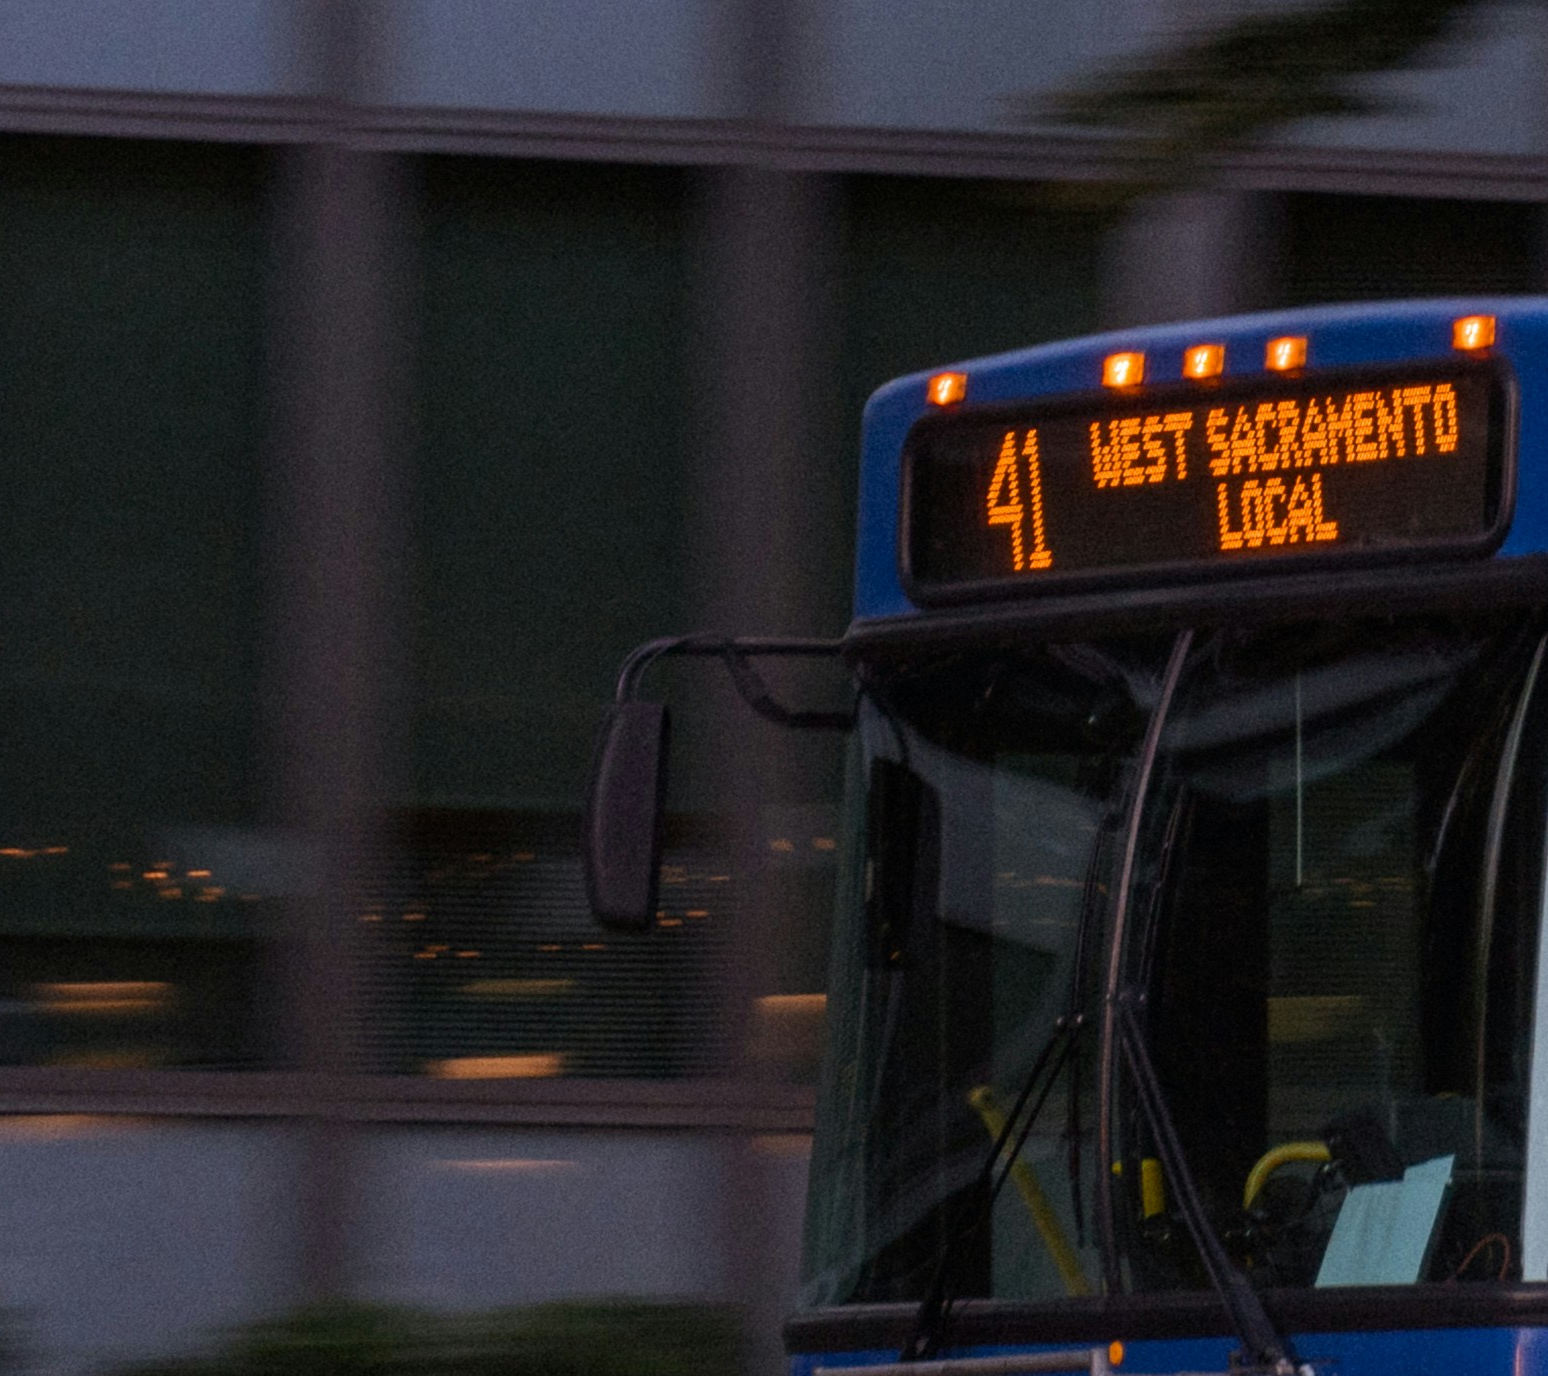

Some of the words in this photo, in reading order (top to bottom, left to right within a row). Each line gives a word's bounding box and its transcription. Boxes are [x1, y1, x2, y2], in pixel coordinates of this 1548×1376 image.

[1089, 412, 1194, 489] WEST
[1205, 383, 1459, 477] SACRAMENTO
[986, 429, 1052, 571] 41
[1218, 473, 1339, 551] LOCAL
